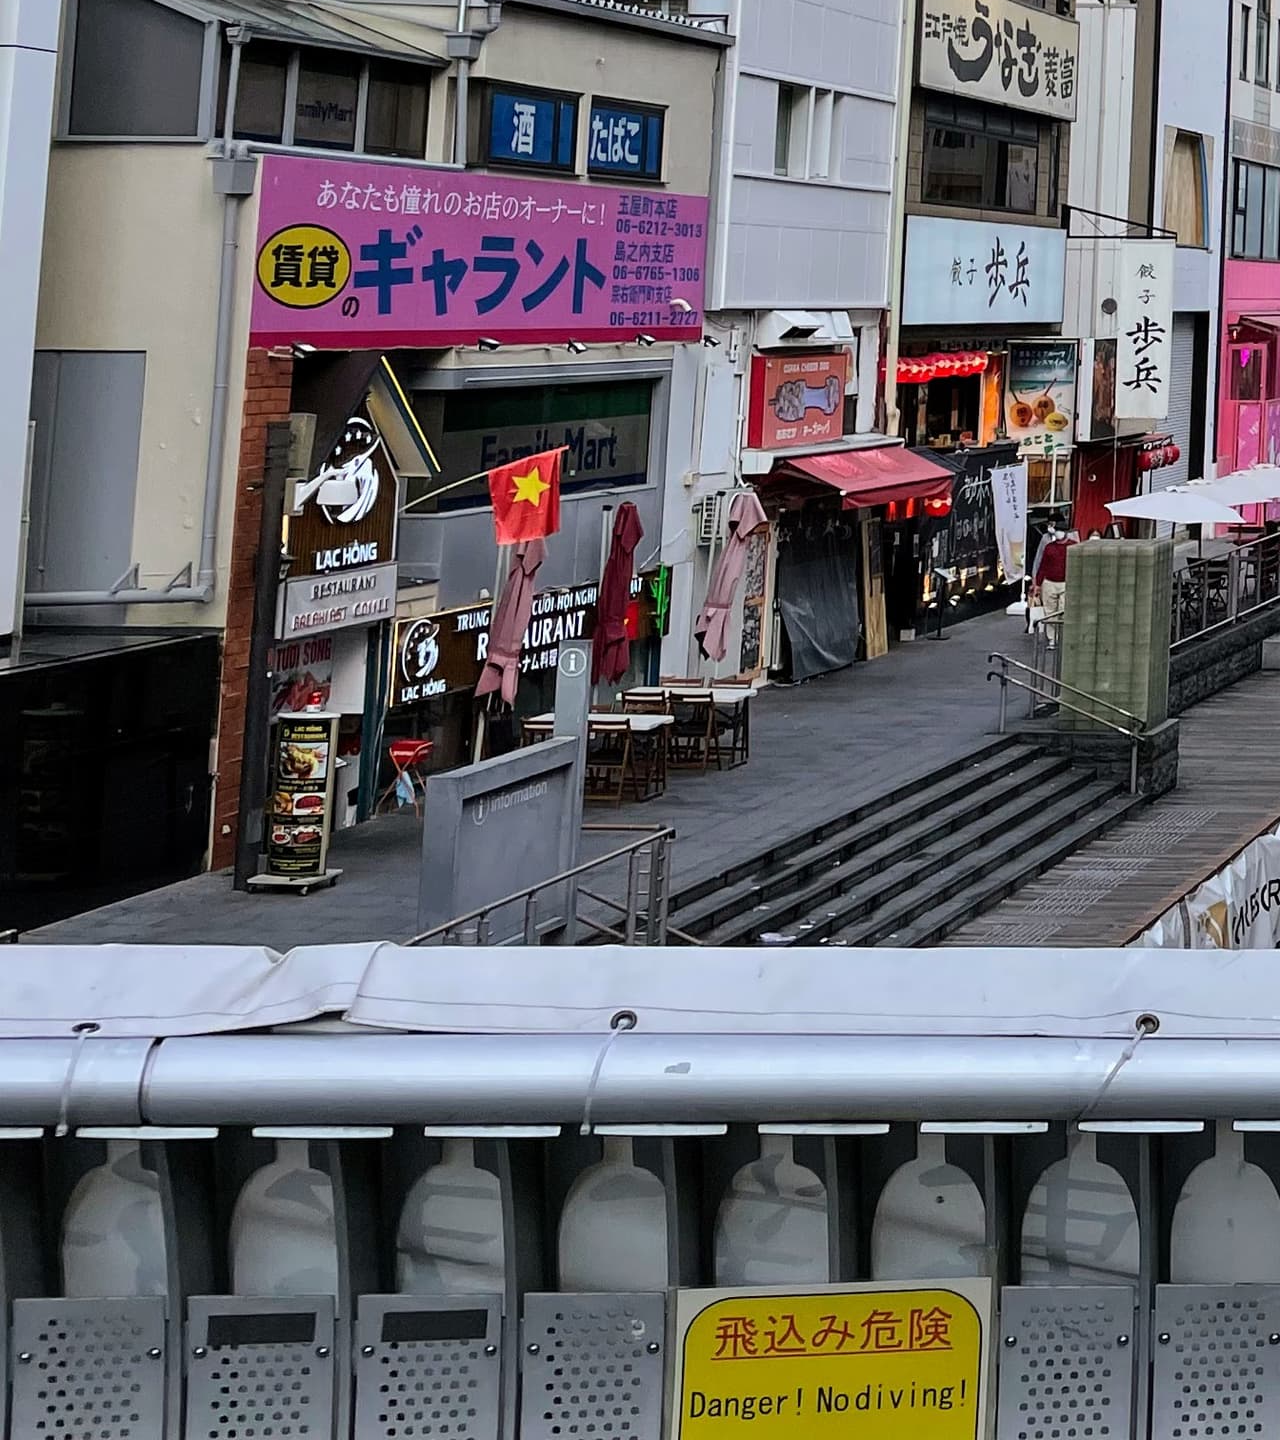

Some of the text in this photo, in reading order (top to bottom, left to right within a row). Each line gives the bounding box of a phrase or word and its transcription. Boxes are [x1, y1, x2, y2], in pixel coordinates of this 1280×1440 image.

[947, 0, 1042, 98] うなぎ
[295, 100, 354, 123] amilyMart
[510, 101, 538, 156] 酒
[589, 113, 640, 165] たばこ
[615, 218, 703, 238] 06-6212-3013
[270, 224, 607, 319] 賃貸 の ギャラント
[612, 265, 700, 281] 06-6765-1306
[984, 235, 1031, 309] 歩兵
[1122, 316, 1167, 393] 歩兵
[311, 574, 378, 602] RESTAURANT
[457, 610, 489, 633] TRUNG
[490, 781, 548, 812] information
[714, 1306, 953, 1358] 飛込み危険
[689, 1388, 803, 1421] Danger!
